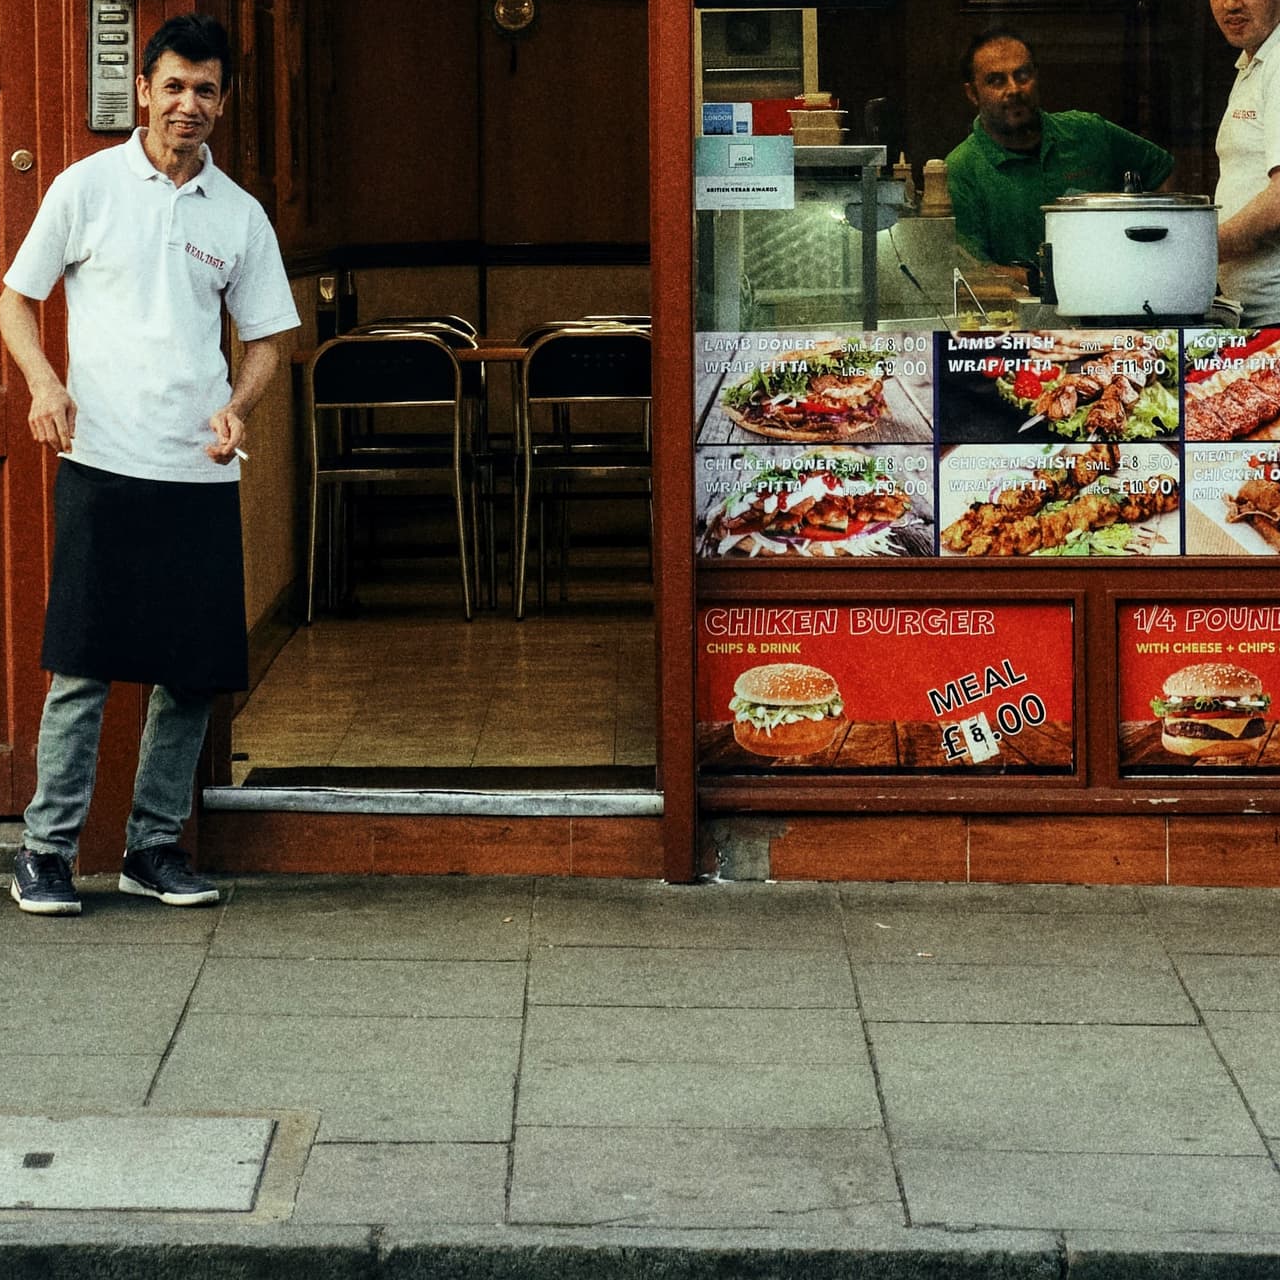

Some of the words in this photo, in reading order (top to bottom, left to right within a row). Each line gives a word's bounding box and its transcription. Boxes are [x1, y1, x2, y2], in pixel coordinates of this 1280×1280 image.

[185, 242, 205, 262] REAL
[704, 338, 751, 351] LAMB
[758, 338, 817, 350] DONER
[874, 336, 927, 352] £8.00
[948, 337, 996, 351] LAMB
[1001, 336, 1054, 350] SHISH
[1112, 335, 1166, 351] £8.50
[1193, 335, 1247, 348] KOFTA
[874, 360, 927, 376] £9.00
[948, 357, 1053, 372] WRAP/PITTA
[705, 458, 776, 470] CHICKEN
[782, 457, 837, 470] DONER
[949, 457, 1020, 470] CHICKEN
[1025, 456, 1076, 469] SHISH
[1085, 461, 1110, 471] SML
[1118, 454, 1172, 471] £8.50
[1193, 450, 1236, 462] MEAT
[1193, 469, 1265, 481] CHICKEN
[705, 607, 838, 636] CHIKEN
[850, 607, 995, 636] BURGER
[1133, 605, 1176, 633] 1/4
[706, 642, 744, 654] CHIPS
[747, 643, 757, 654] &
[760, 642, 802, 654] DRINK
[1136, 643, 1170, 654] WITH
[1173, 642, 1223, 654] CHEESE
[1238, 642, 1276, 654] CHIPS
[926, 658, 1027, 717] MEAL
